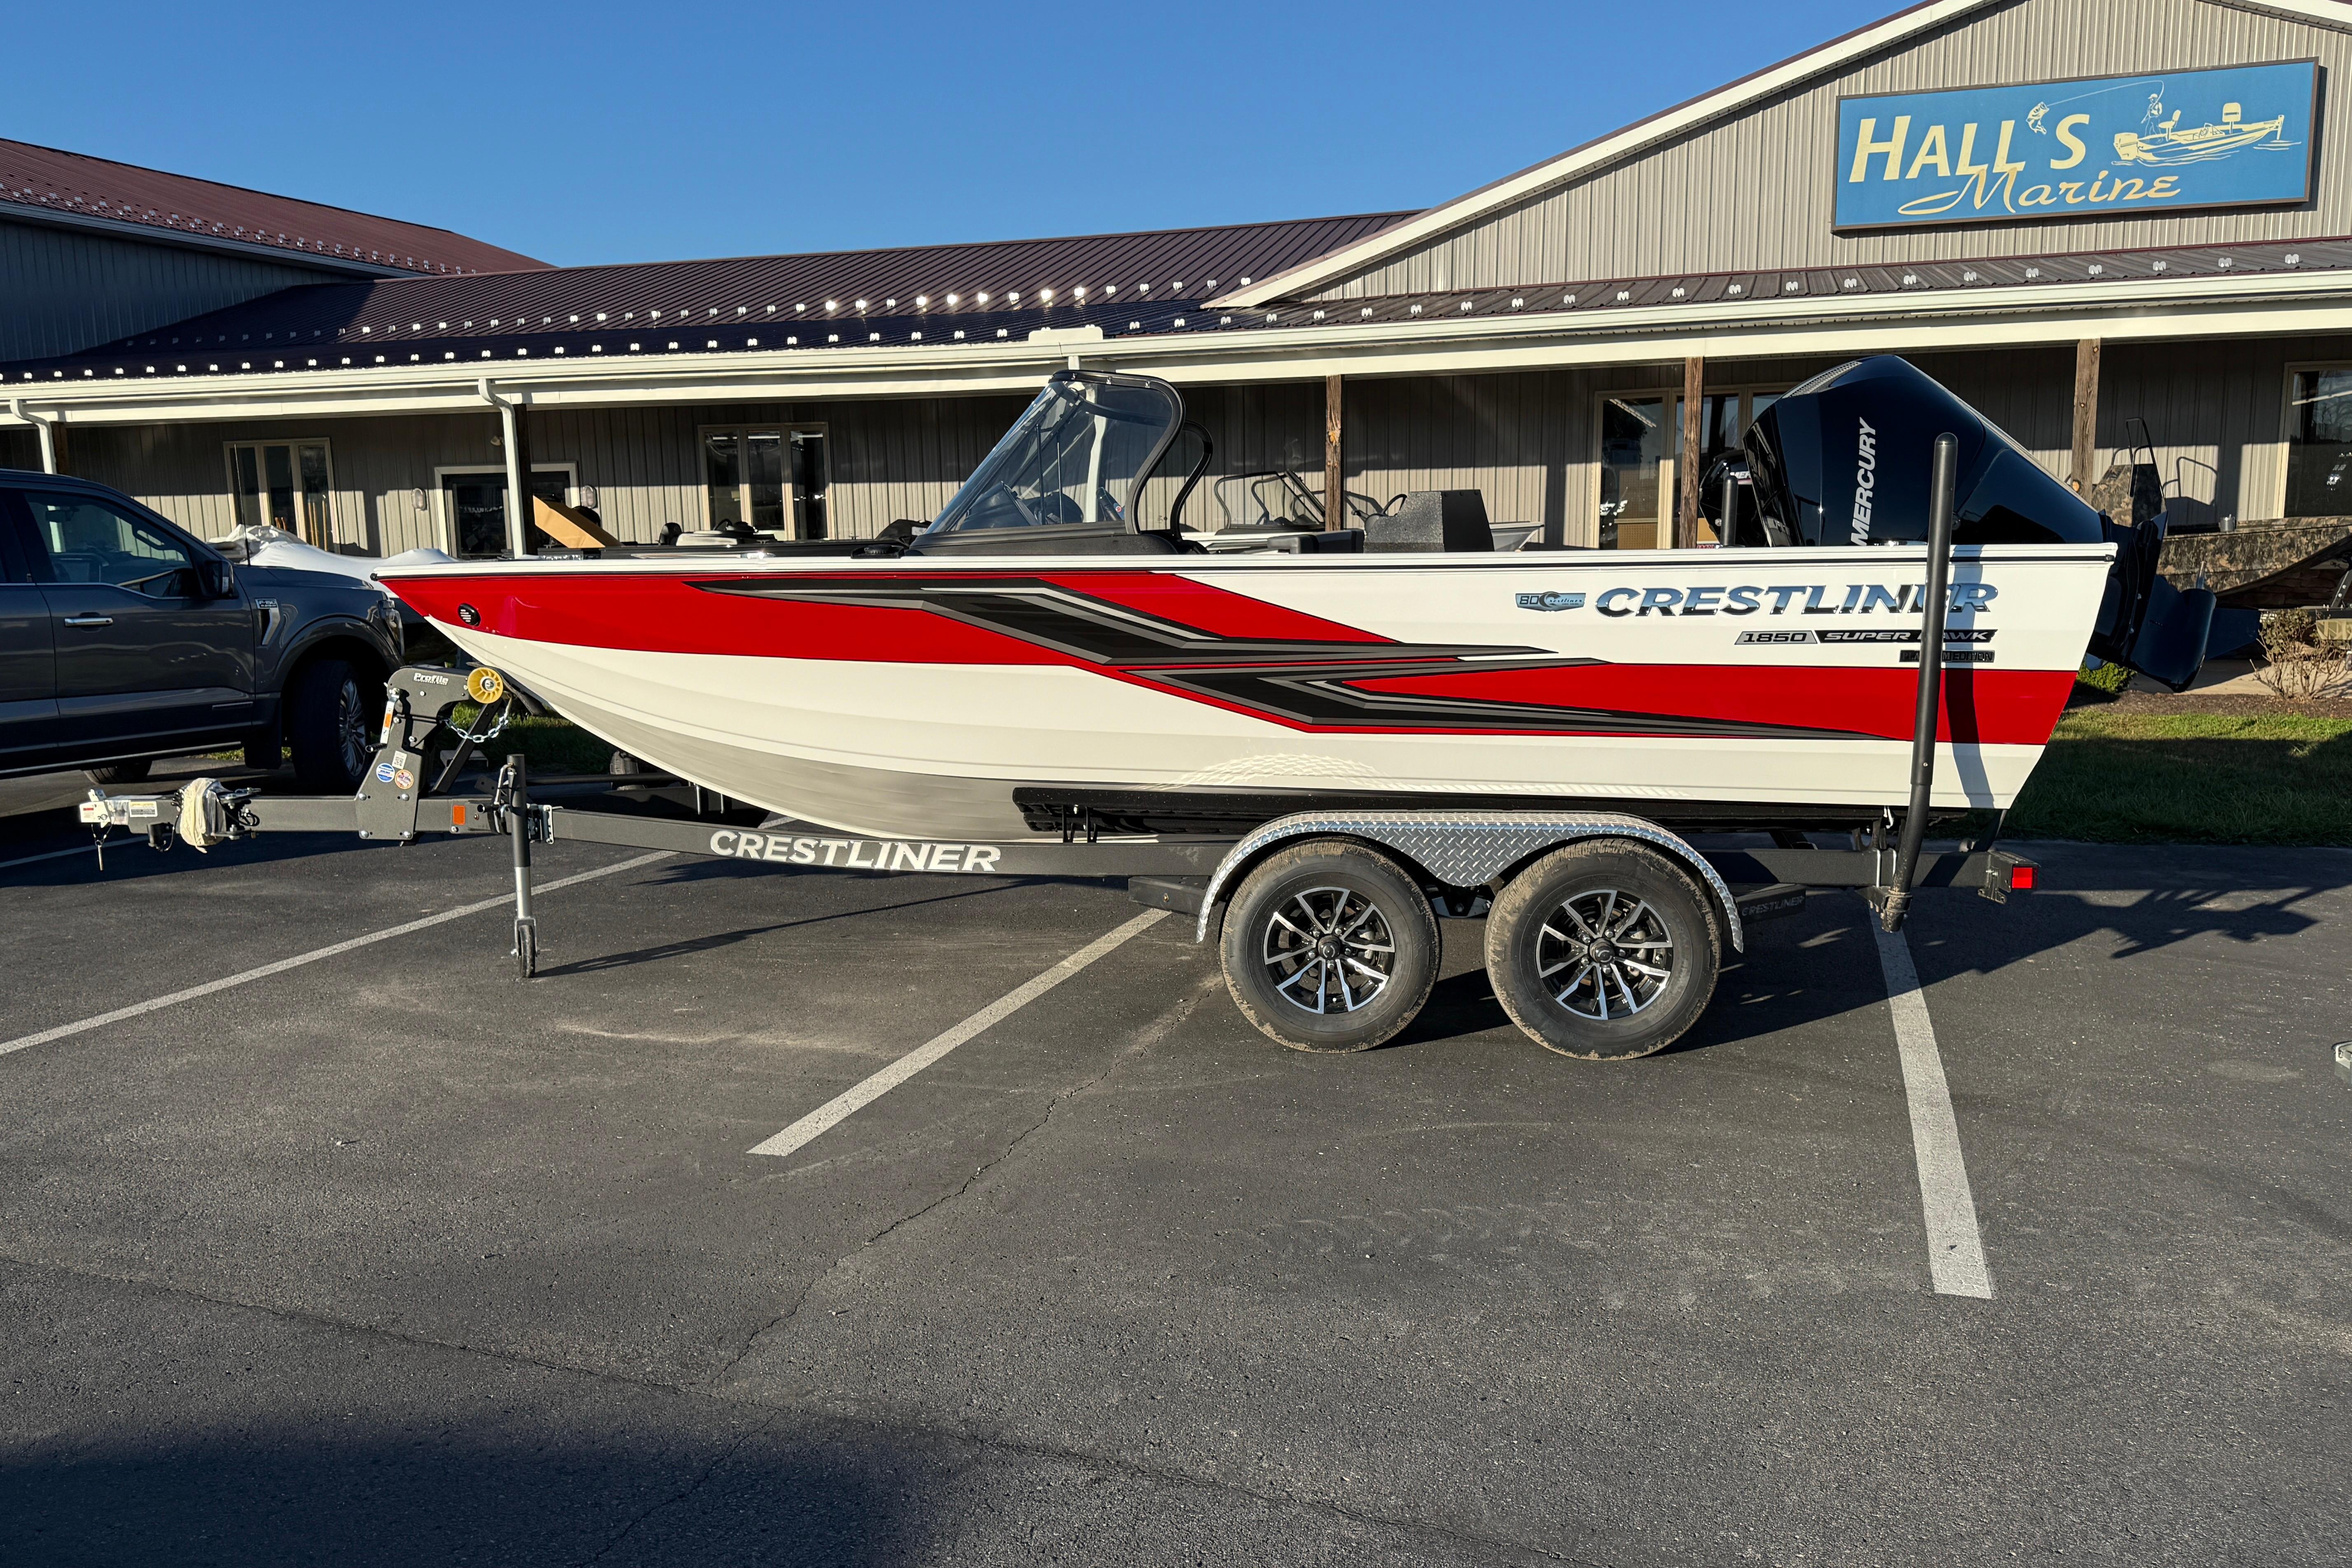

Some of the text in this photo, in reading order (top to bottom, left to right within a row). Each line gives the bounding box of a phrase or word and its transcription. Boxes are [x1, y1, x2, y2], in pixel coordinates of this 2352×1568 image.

[1897, 169, 2181, 215] Marine
[1851, 417, 1876, 546] MERCURY
[1743, 632, 1988, 642] 1850 SUPER WK
[413, 672, 449, 684] Profile
[710, 829, 1001, 872] CRESTLINER
[1742, 895, 1804, 916] CRESTLINER
